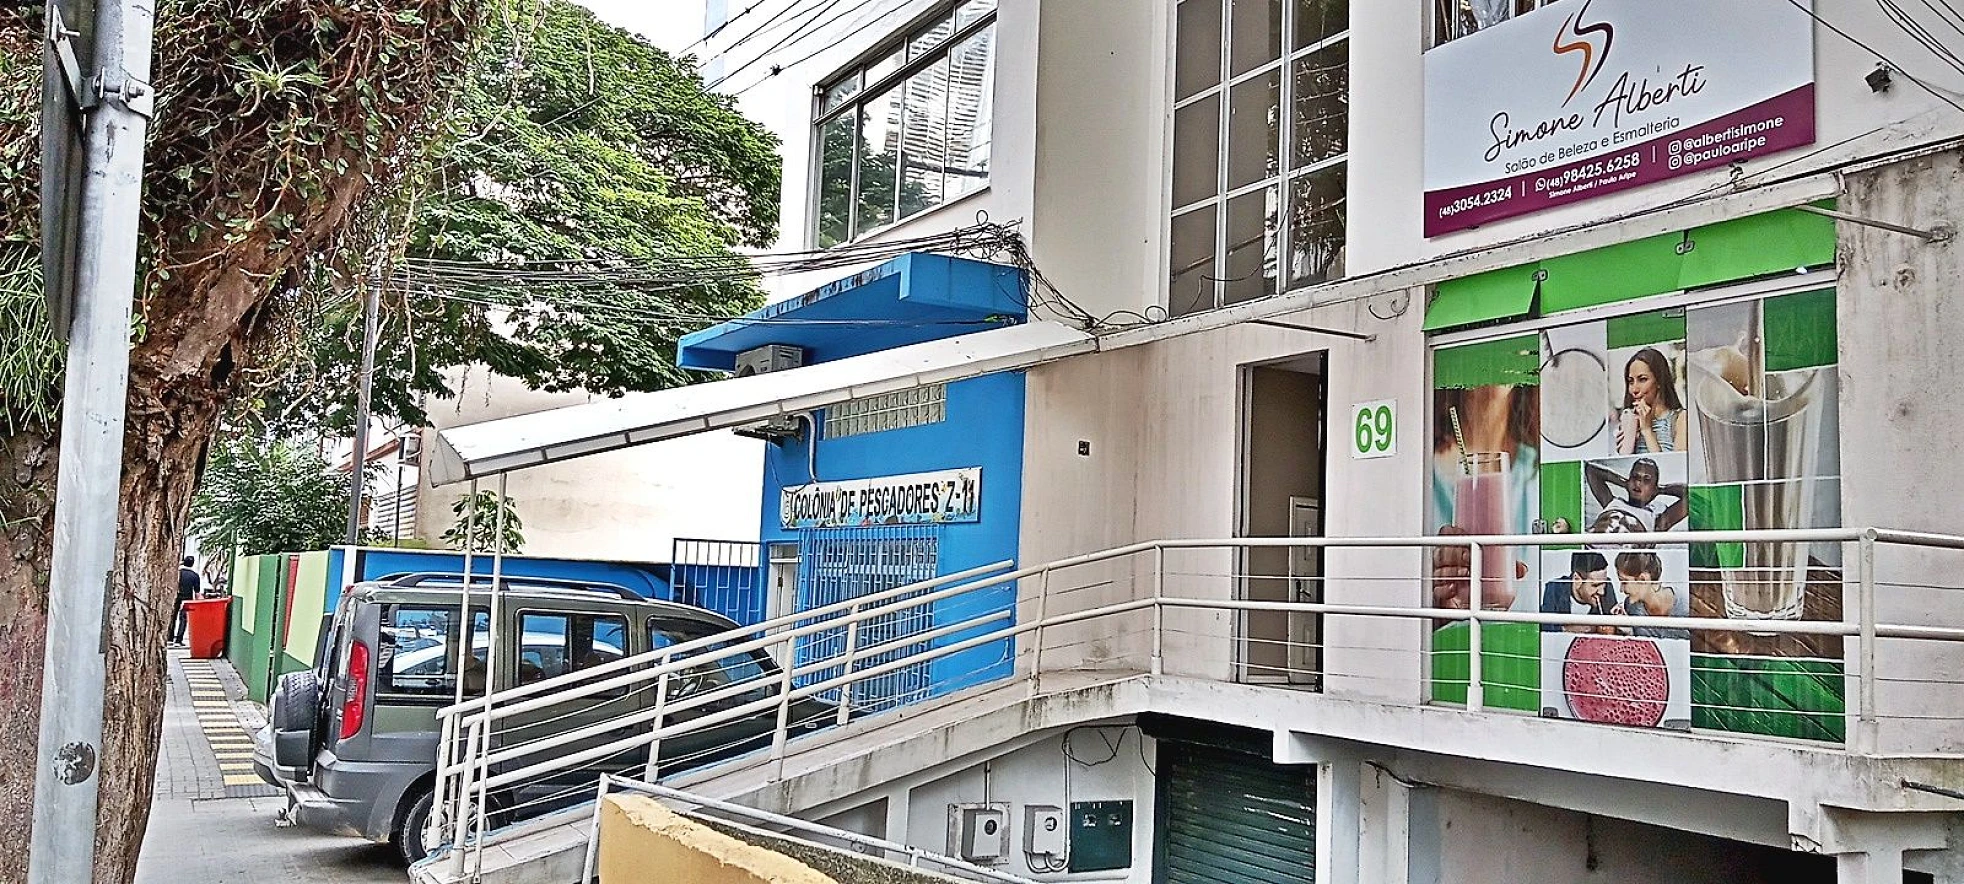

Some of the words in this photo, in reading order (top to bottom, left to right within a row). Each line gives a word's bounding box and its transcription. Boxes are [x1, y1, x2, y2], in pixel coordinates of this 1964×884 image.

[1484, 111, 1584, 162] Simone
[1592, 63, 1707, 128] Alberti
[1504, 156, 1537, 174] Salão
[1539, 150, 1555, 165] de
[1558, 141, 1598, 160] Beleza
[1601, 136, 1610, 147] e
[1613, 115, 1681, 144] Esmalteria
[1683, 116, 1785, 151] @albertisimone
[1683, 135, 1766, 166] @pauloaripe
[1546, 152, 1641, 189] (48)98425.6258
[1548, 187, 1572, 199] Simone
[1572, 181, 1593, 193] Alberti
[1598, 176, 1617, 186] Paulo
[1439, 185, 1512, 218] (48)3054.2324
[1356, 405, 1392, 453] 69
[794, 486, 836, 520] COLÔNIA
[840, 489, 856, 518] DE
[859, 480, 939, 518] PESCADORES
[944, 479, 976, 514] Z-11
